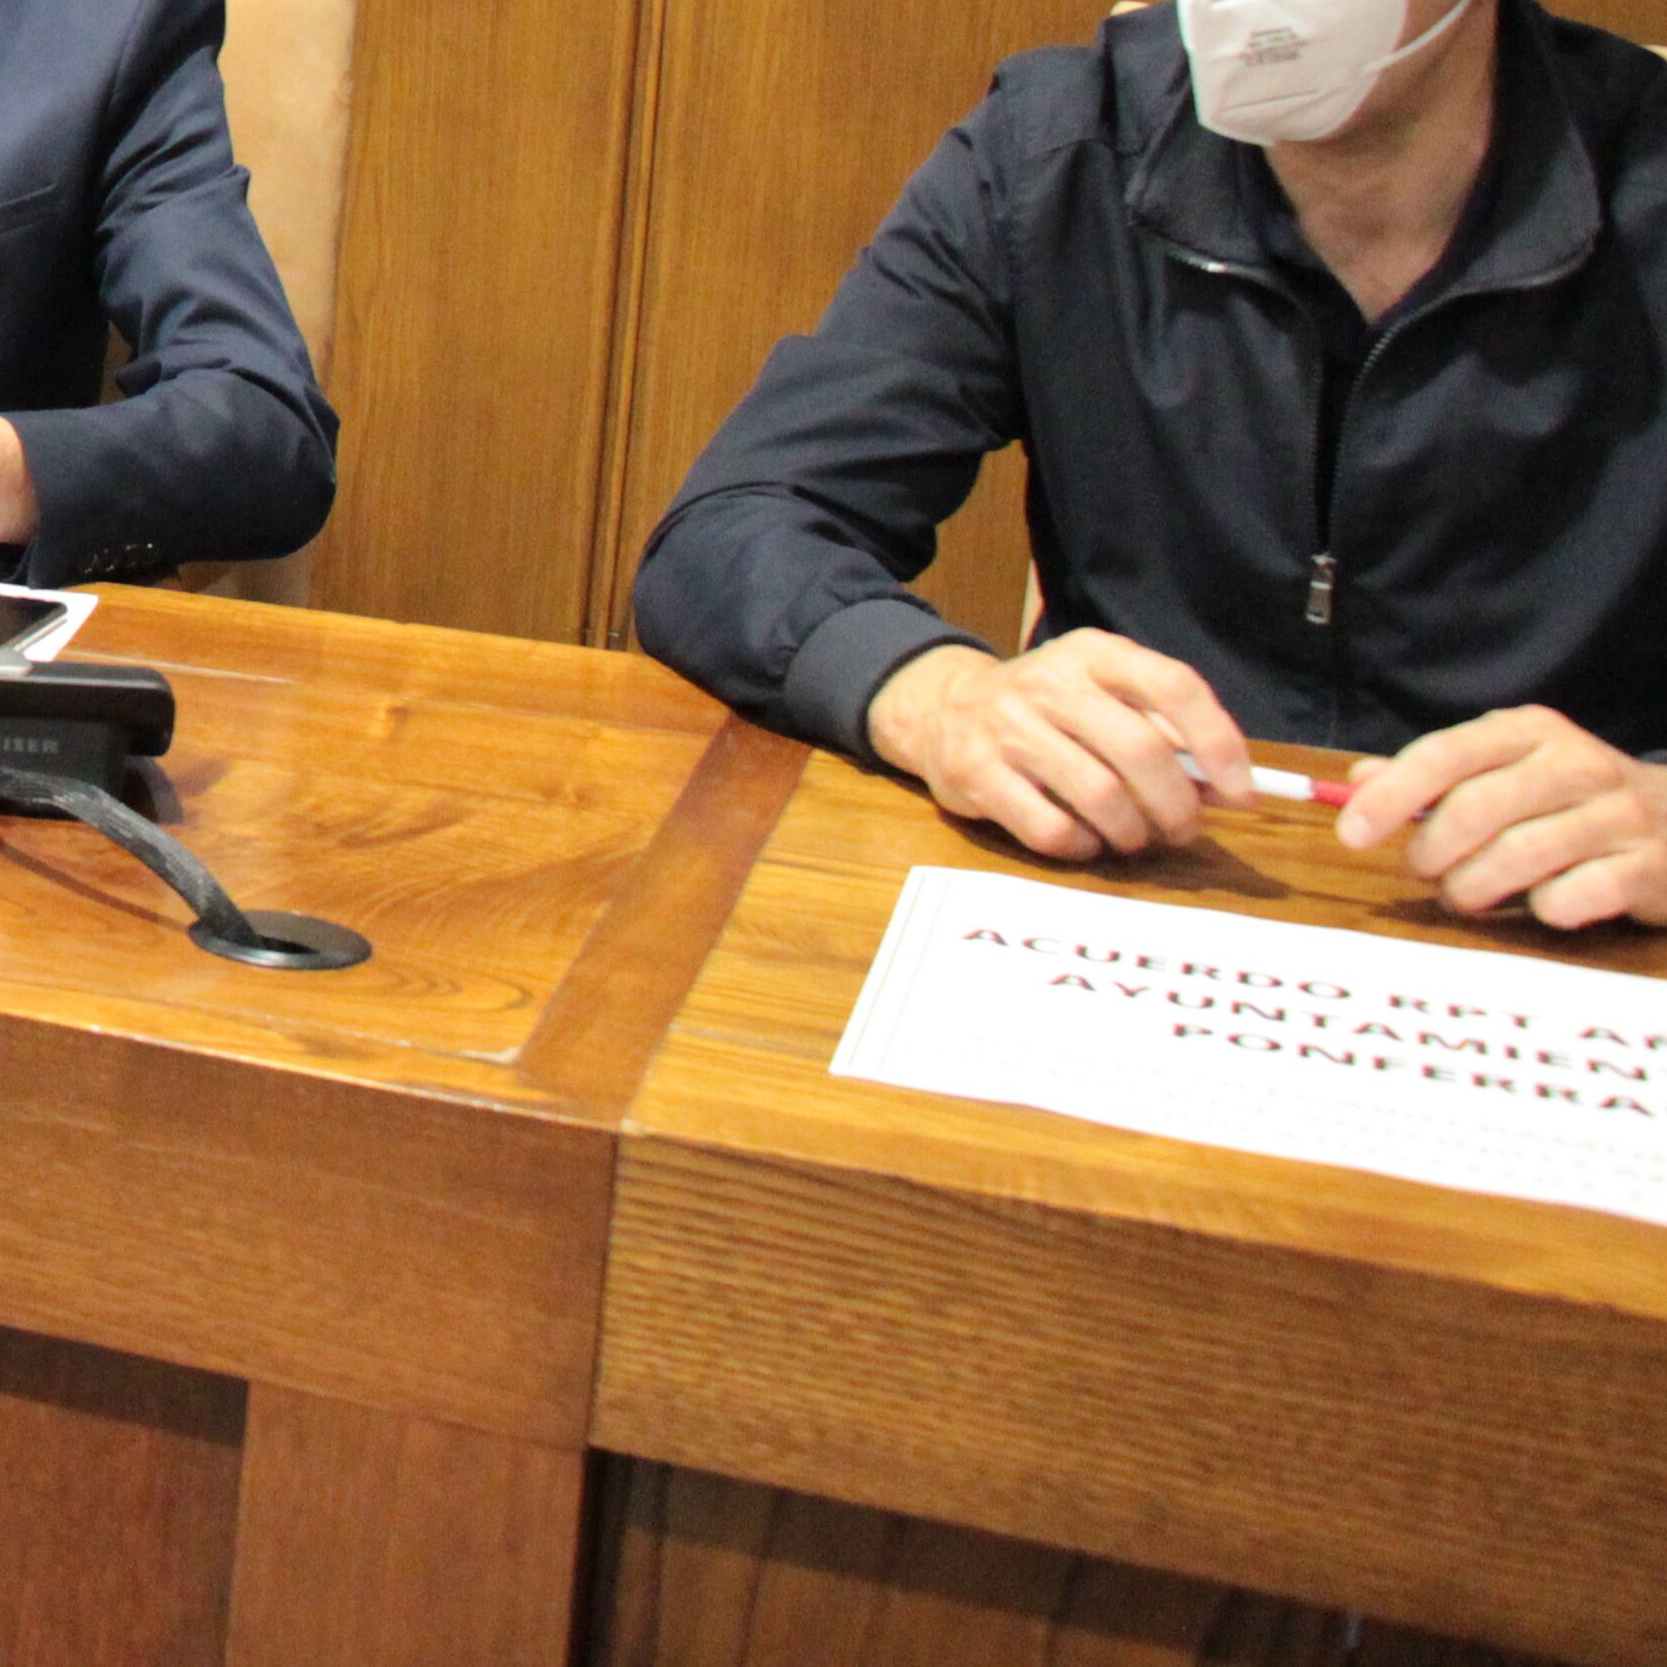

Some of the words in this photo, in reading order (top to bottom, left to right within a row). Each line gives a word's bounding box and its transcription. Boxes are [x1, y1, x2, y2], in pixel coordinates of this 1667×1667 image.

[962, 929, 1353, 1000] ACUERDO
[1387, 994, 1537, 1031] RPT
[1048, 973, 1667, 1083] AYUNTAMIEN
[1171, 1023, 1667, 1118] PONFERRA
